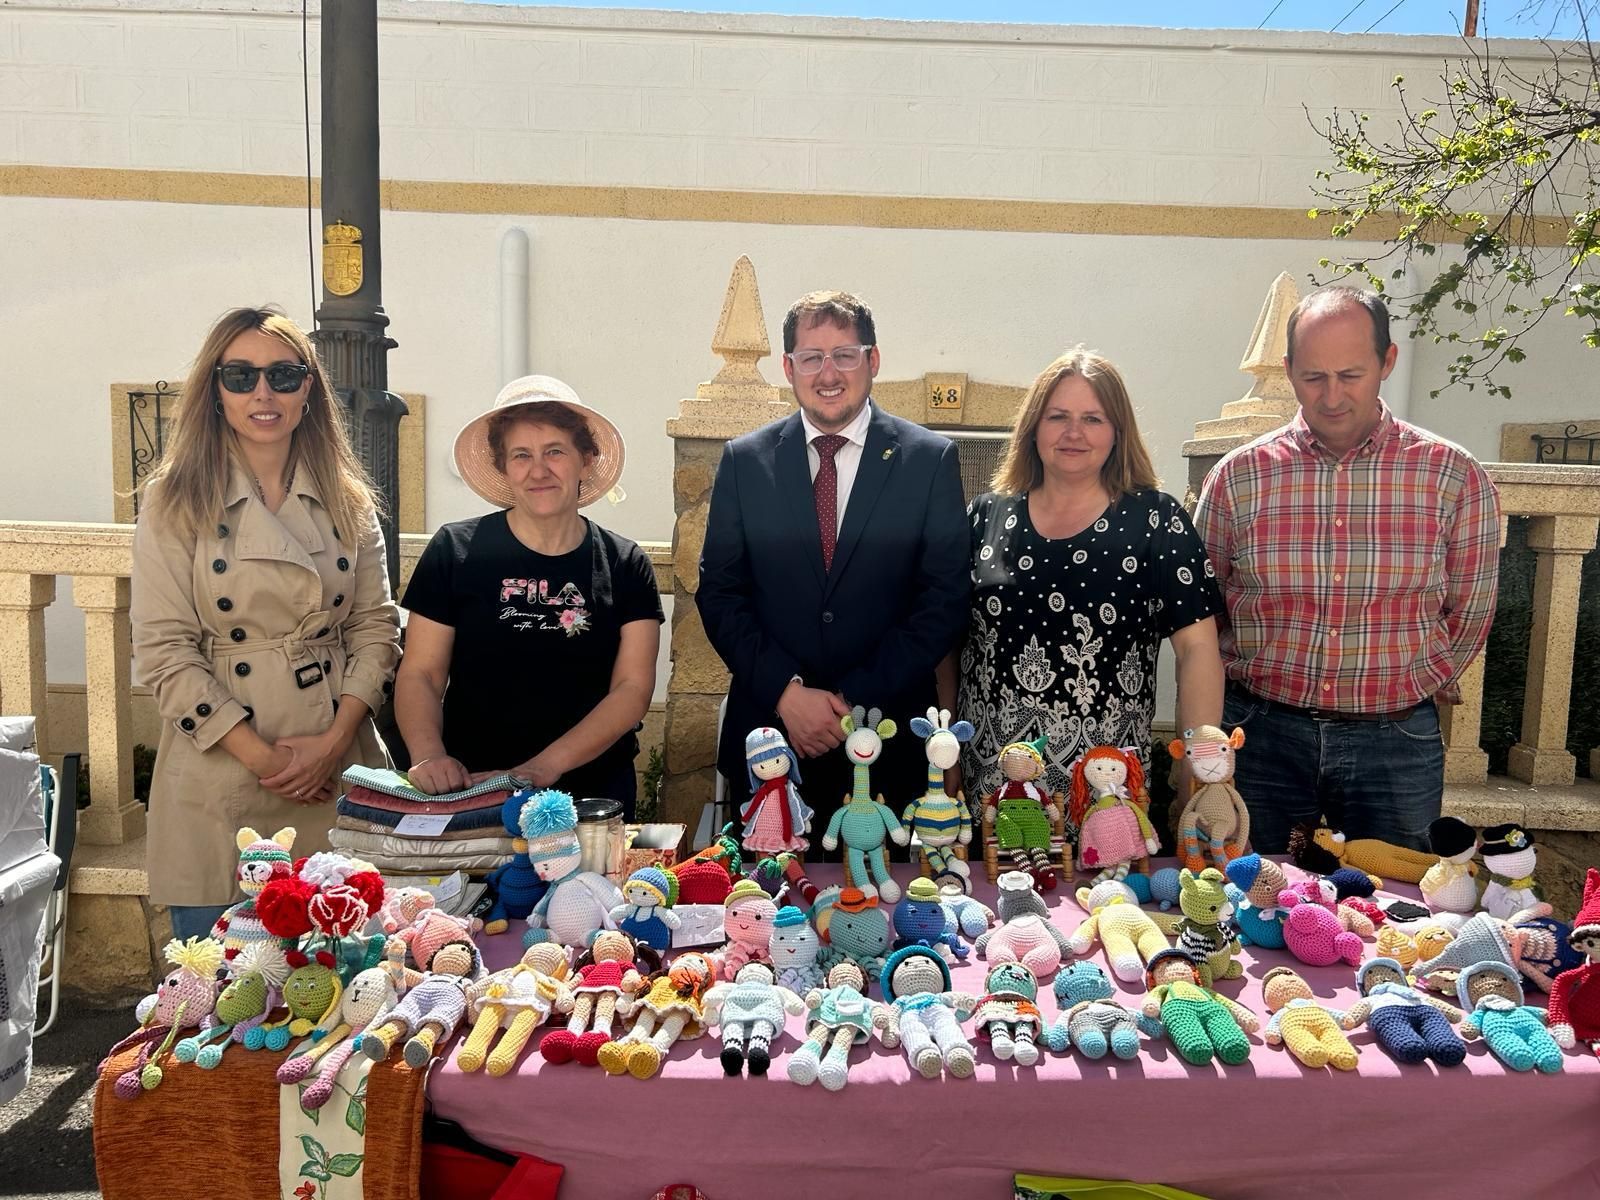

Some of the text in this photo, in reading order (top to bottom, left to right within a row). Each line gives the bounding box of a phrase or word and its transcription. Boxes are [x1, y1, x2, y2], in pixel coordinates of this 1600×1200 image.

[946, 388, 958, 404] 8
[500, 578, 586, 606] FILA
[499, 606, 547, 621] Blooming
[513, 621, 533, 631] with
